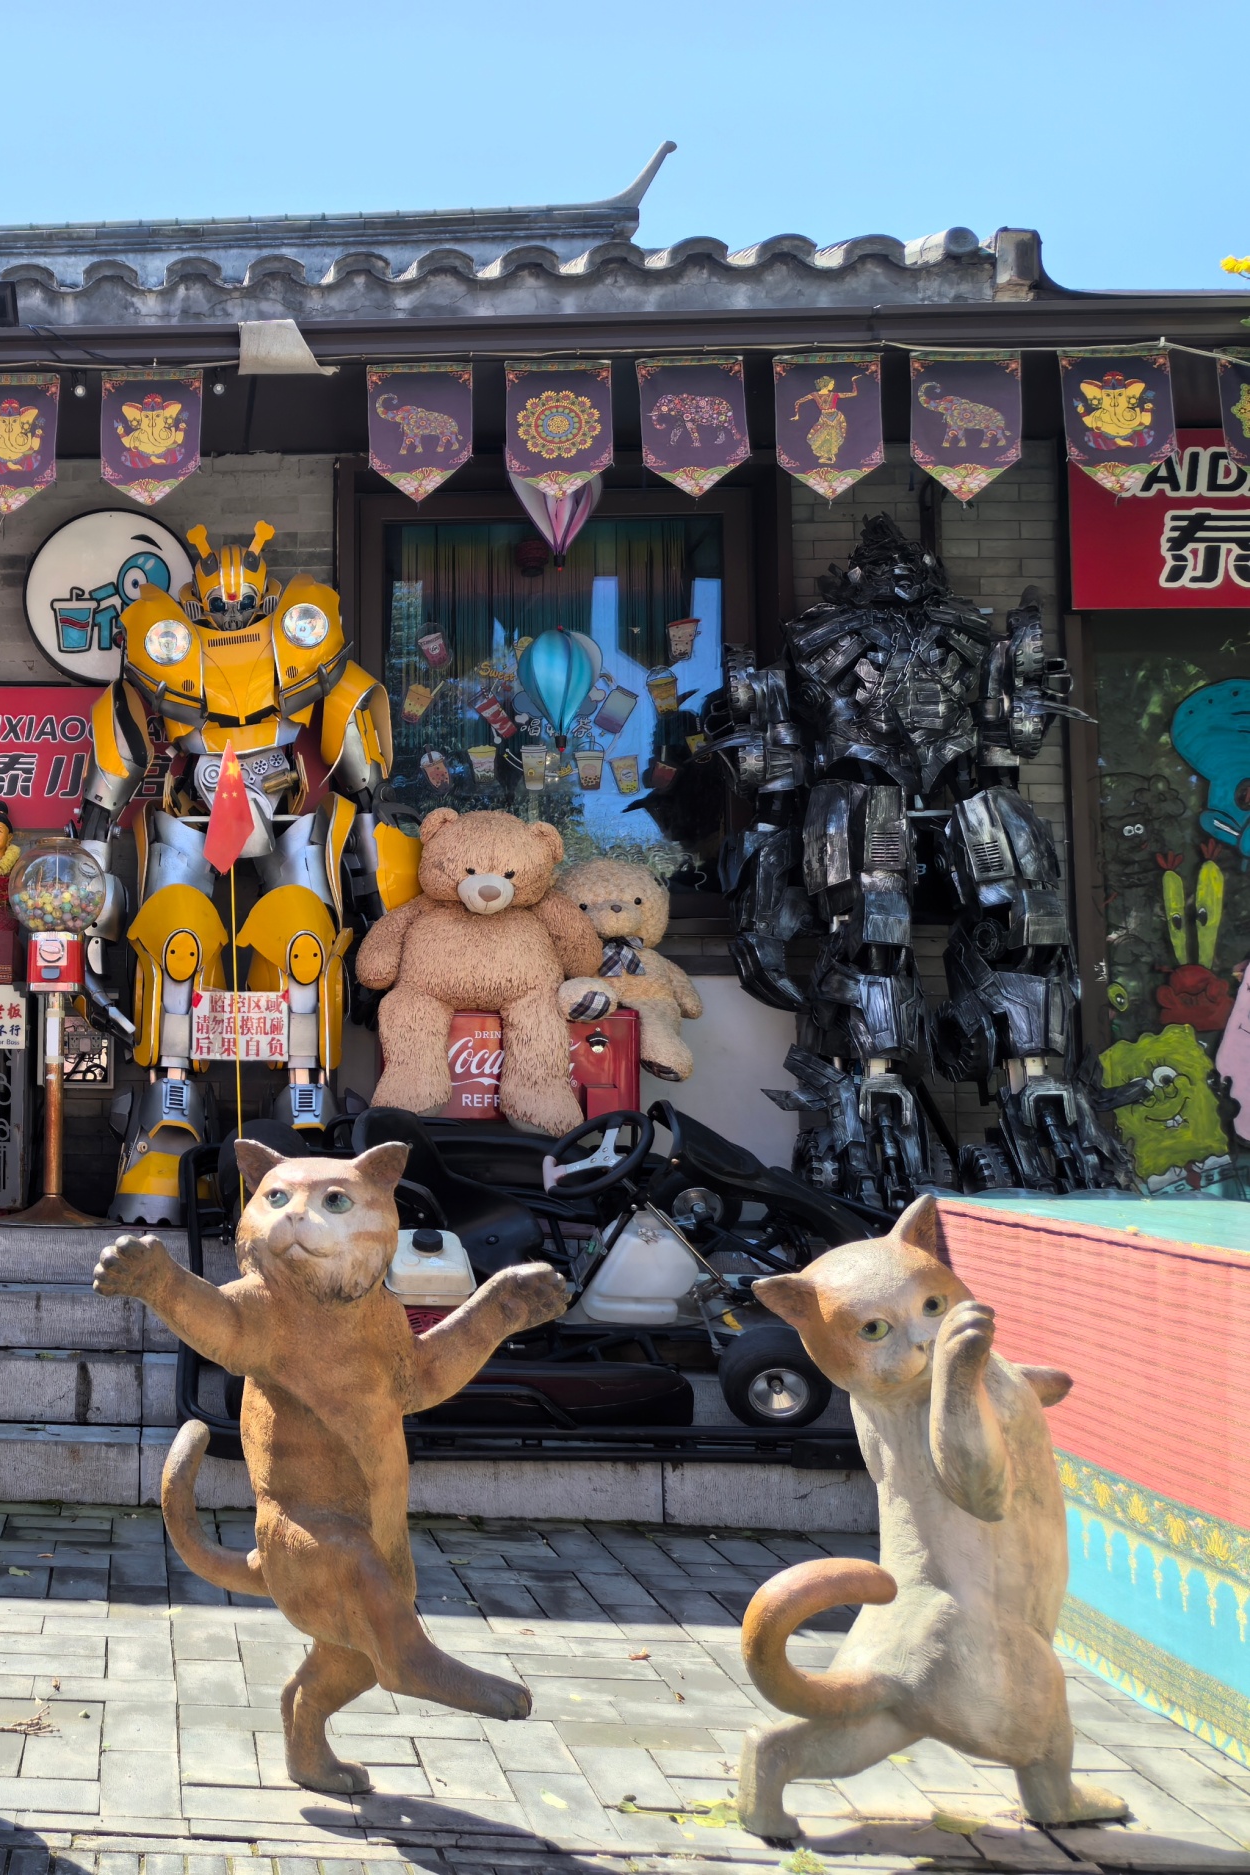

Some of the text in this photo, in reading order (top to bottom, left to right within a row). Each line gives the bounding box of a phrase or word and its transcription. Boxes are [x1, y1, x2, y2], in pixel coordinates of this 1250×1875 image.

[1121, 447, 1250, 497] AID
[479, 661, 515, 682] Sweet
[210, 993, 283, 1015] 监控区域
[195, 1015, 285, 1036] 请勿乱摸乱碰
[474, 1030, 503, 1039] DRIN
[194, 1036, 285, 1057] 后果自负
